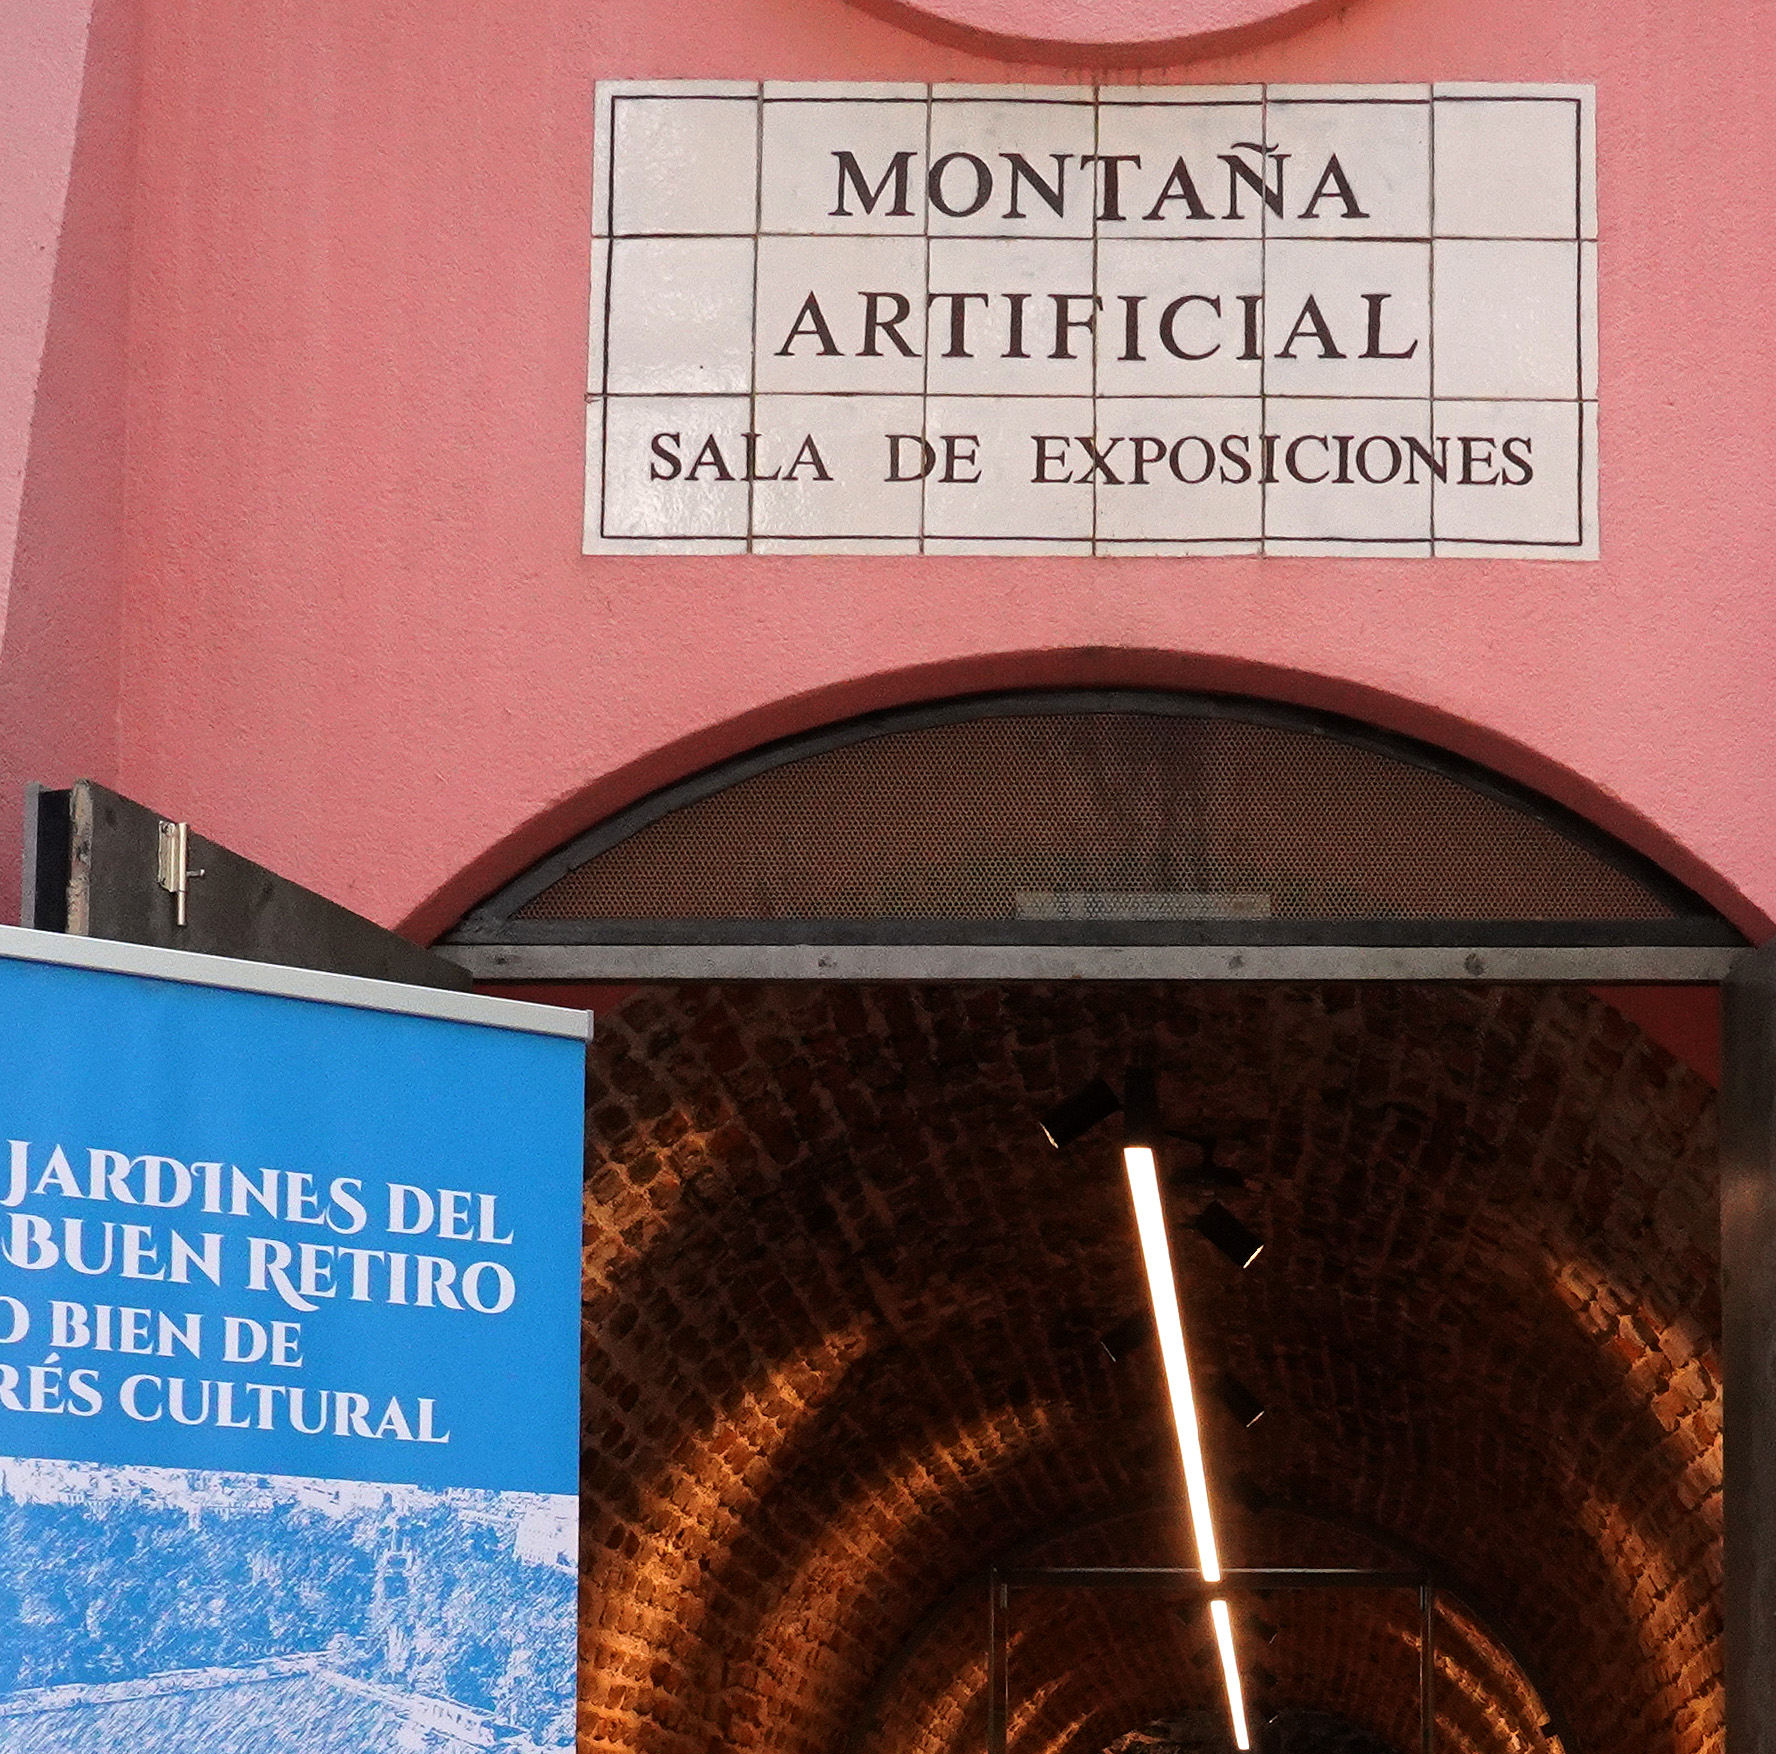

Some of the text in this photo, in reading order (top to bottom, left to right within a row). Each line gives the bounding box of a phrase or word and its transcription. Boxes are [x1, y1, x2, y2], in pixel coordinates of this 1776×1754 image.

[829, 141, 1369, 222] MONTAÑA
[774, 290, 1418, 361] ARTIFICIAL
[650, 433, 1534, 488] SALA DE EXPOSICIONES
[0, 1139, 514, 1245] JARDINES DEL
[3, 1213, 516, 1315] BUEN RETIRO
[50, 1301, 203, 1361] BIEN
[222, 1317, 303, 1368] DE
[120, 1375, 450, 1444] CULTURAL
